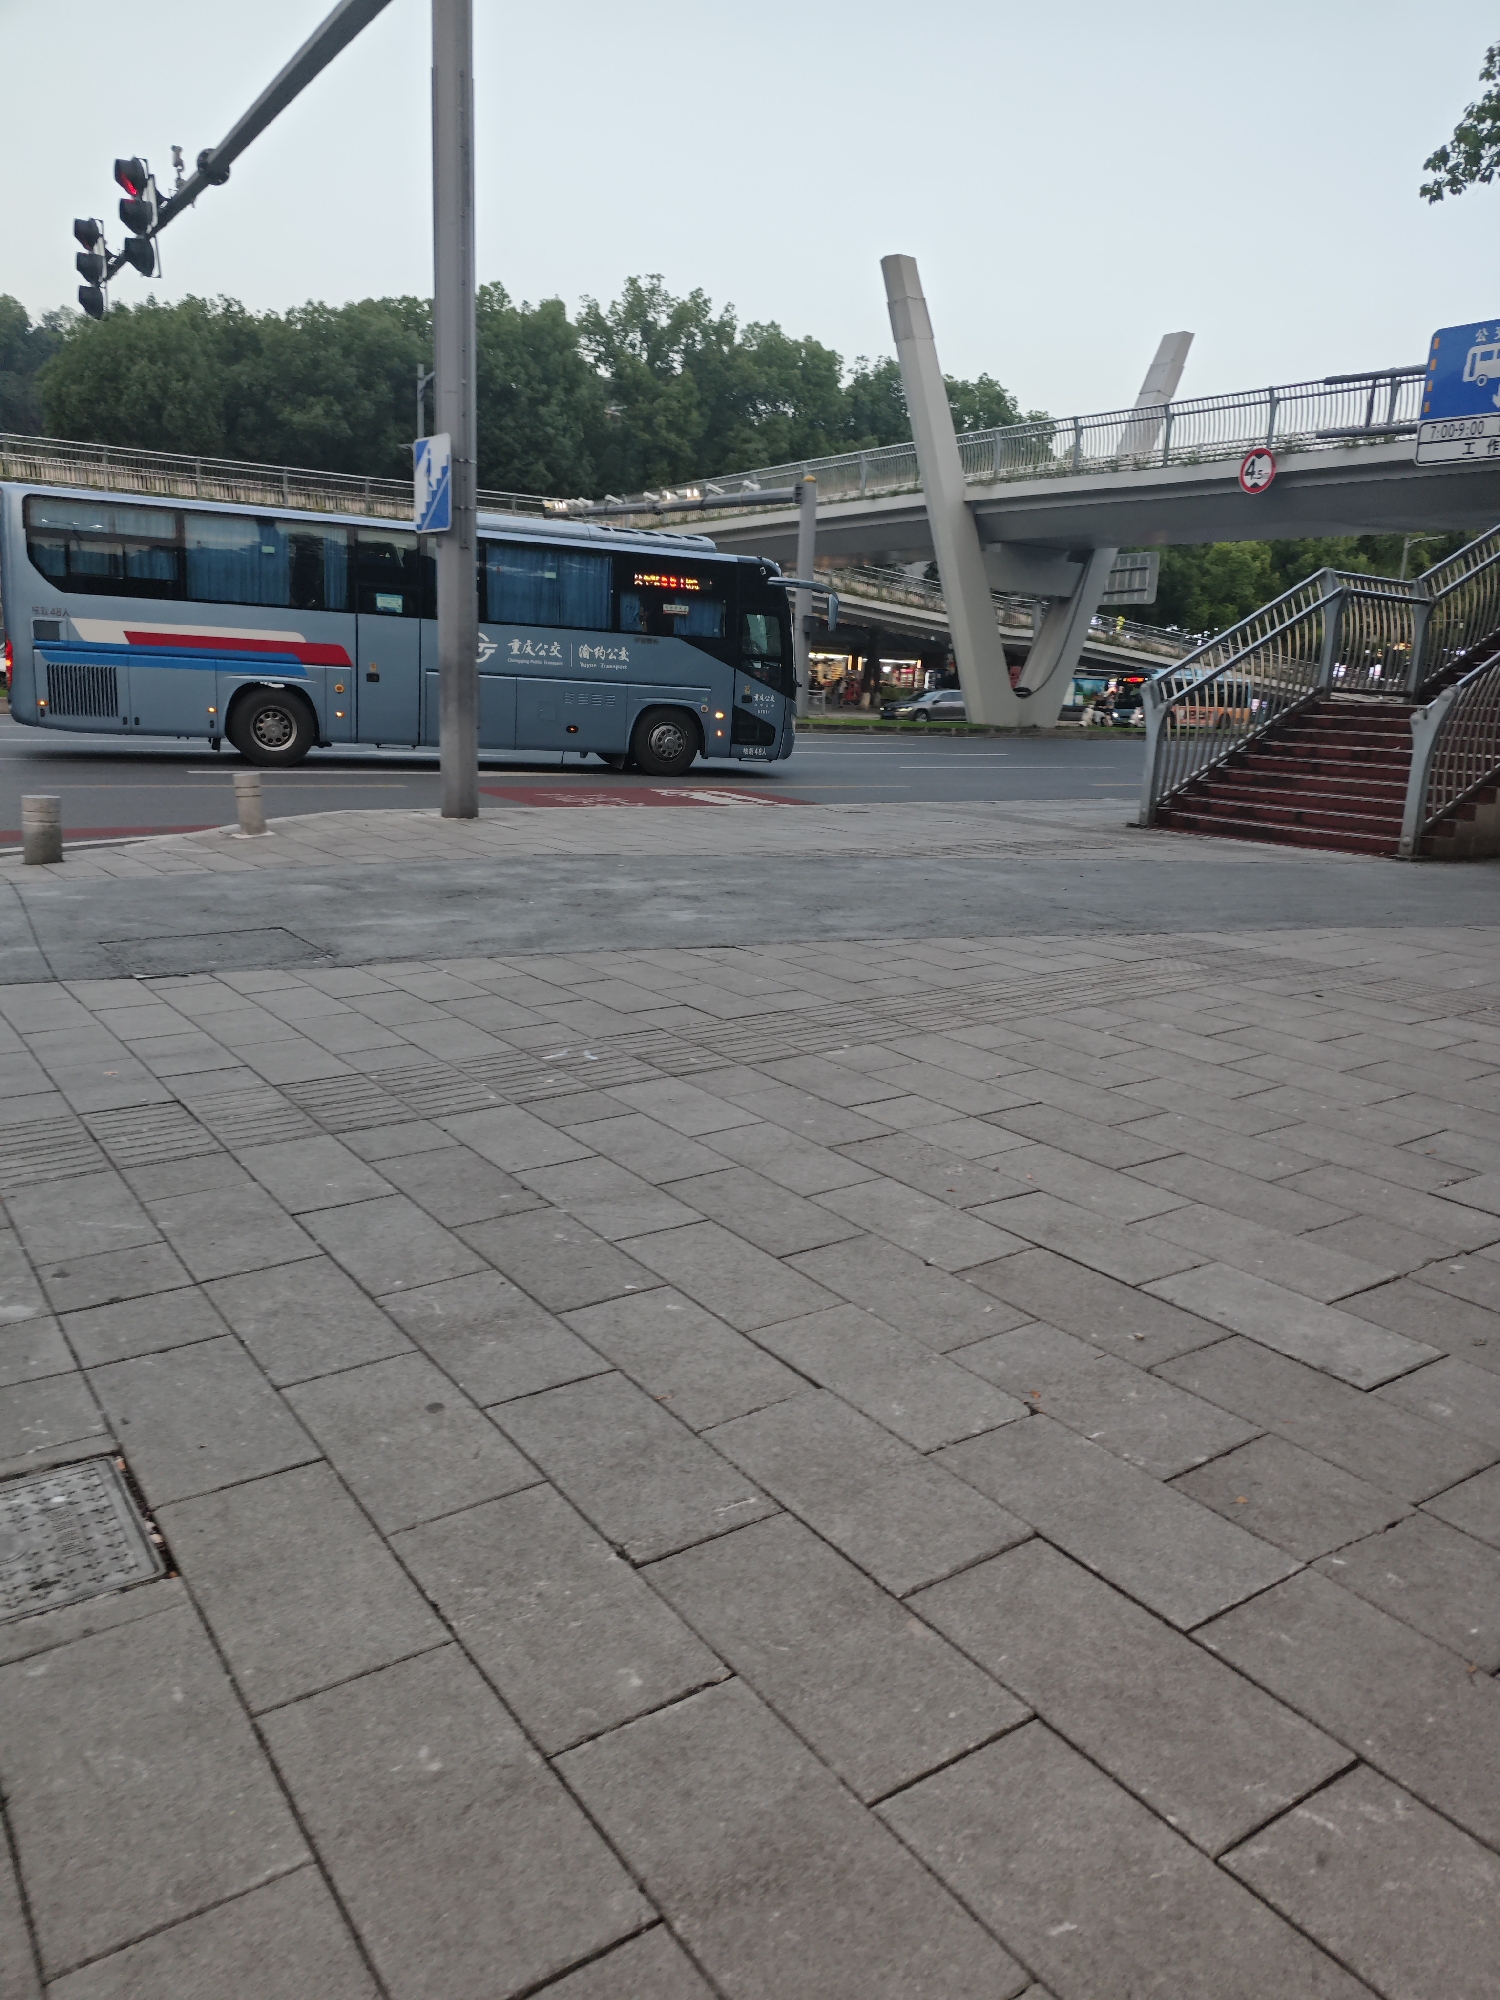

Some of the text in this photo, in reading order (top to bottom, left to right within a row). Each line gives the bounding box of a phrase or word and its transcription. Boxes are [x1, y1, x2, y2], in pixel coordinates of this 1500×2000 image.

[1430, 421, 1485, 439] 7:00-9:00
[507, 638, 562, 658] 重庆公交
[578, 643, 630, 662] 渝约公交
